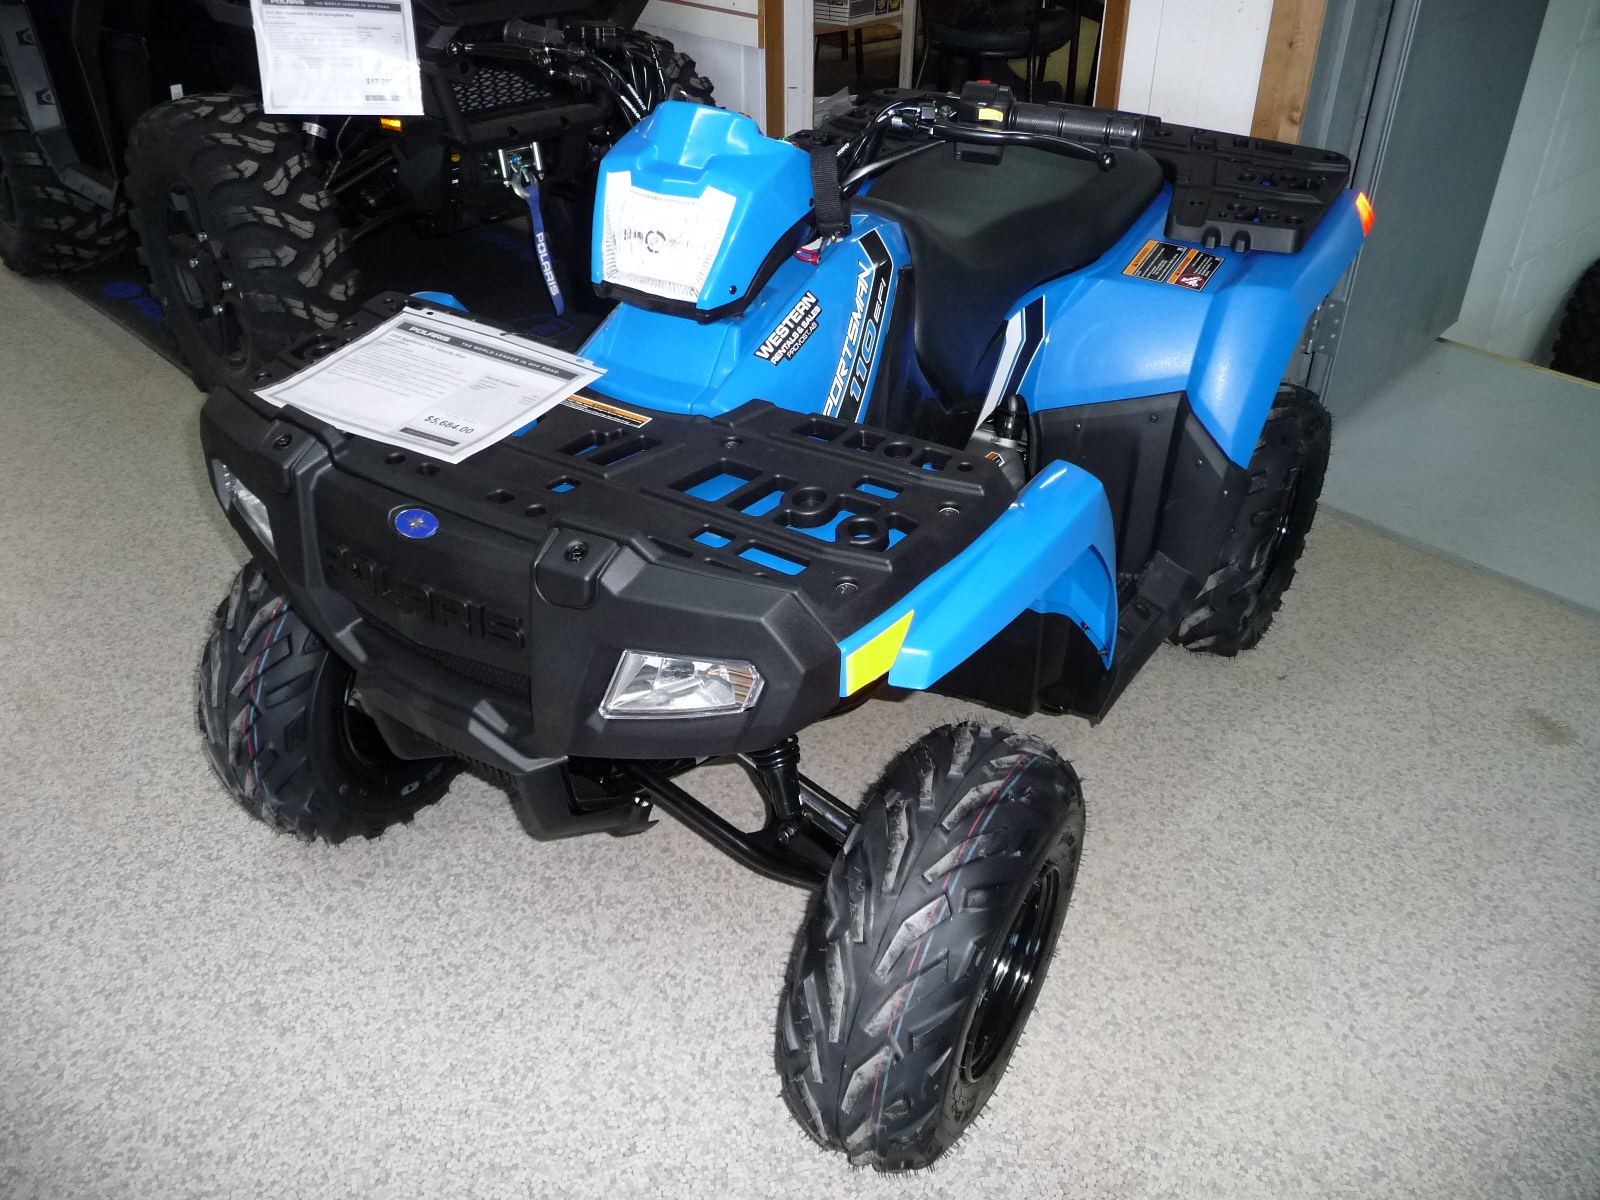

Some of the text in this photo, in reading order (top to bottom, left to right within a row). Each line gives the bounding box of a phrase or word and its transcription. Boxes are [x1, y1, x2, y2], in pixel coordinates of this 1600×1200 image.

[536, 232, 560, 296] POLARIS
[409, 326, 451, 342] POLARIS
[474, 345, 494, 355] WORLD
[495, 352, 519, 362] LEADER
[755, 291, 817, 359] WESTERN
[770, 305, 821, 365] RENTALS & SALES
[809, 321, 818, 333] AB
[822, 258, 873, 417] PORTSMAN
[850, 278, 887, 403] 110 EFI
[424, 415, 474, 435] $5,684.00
